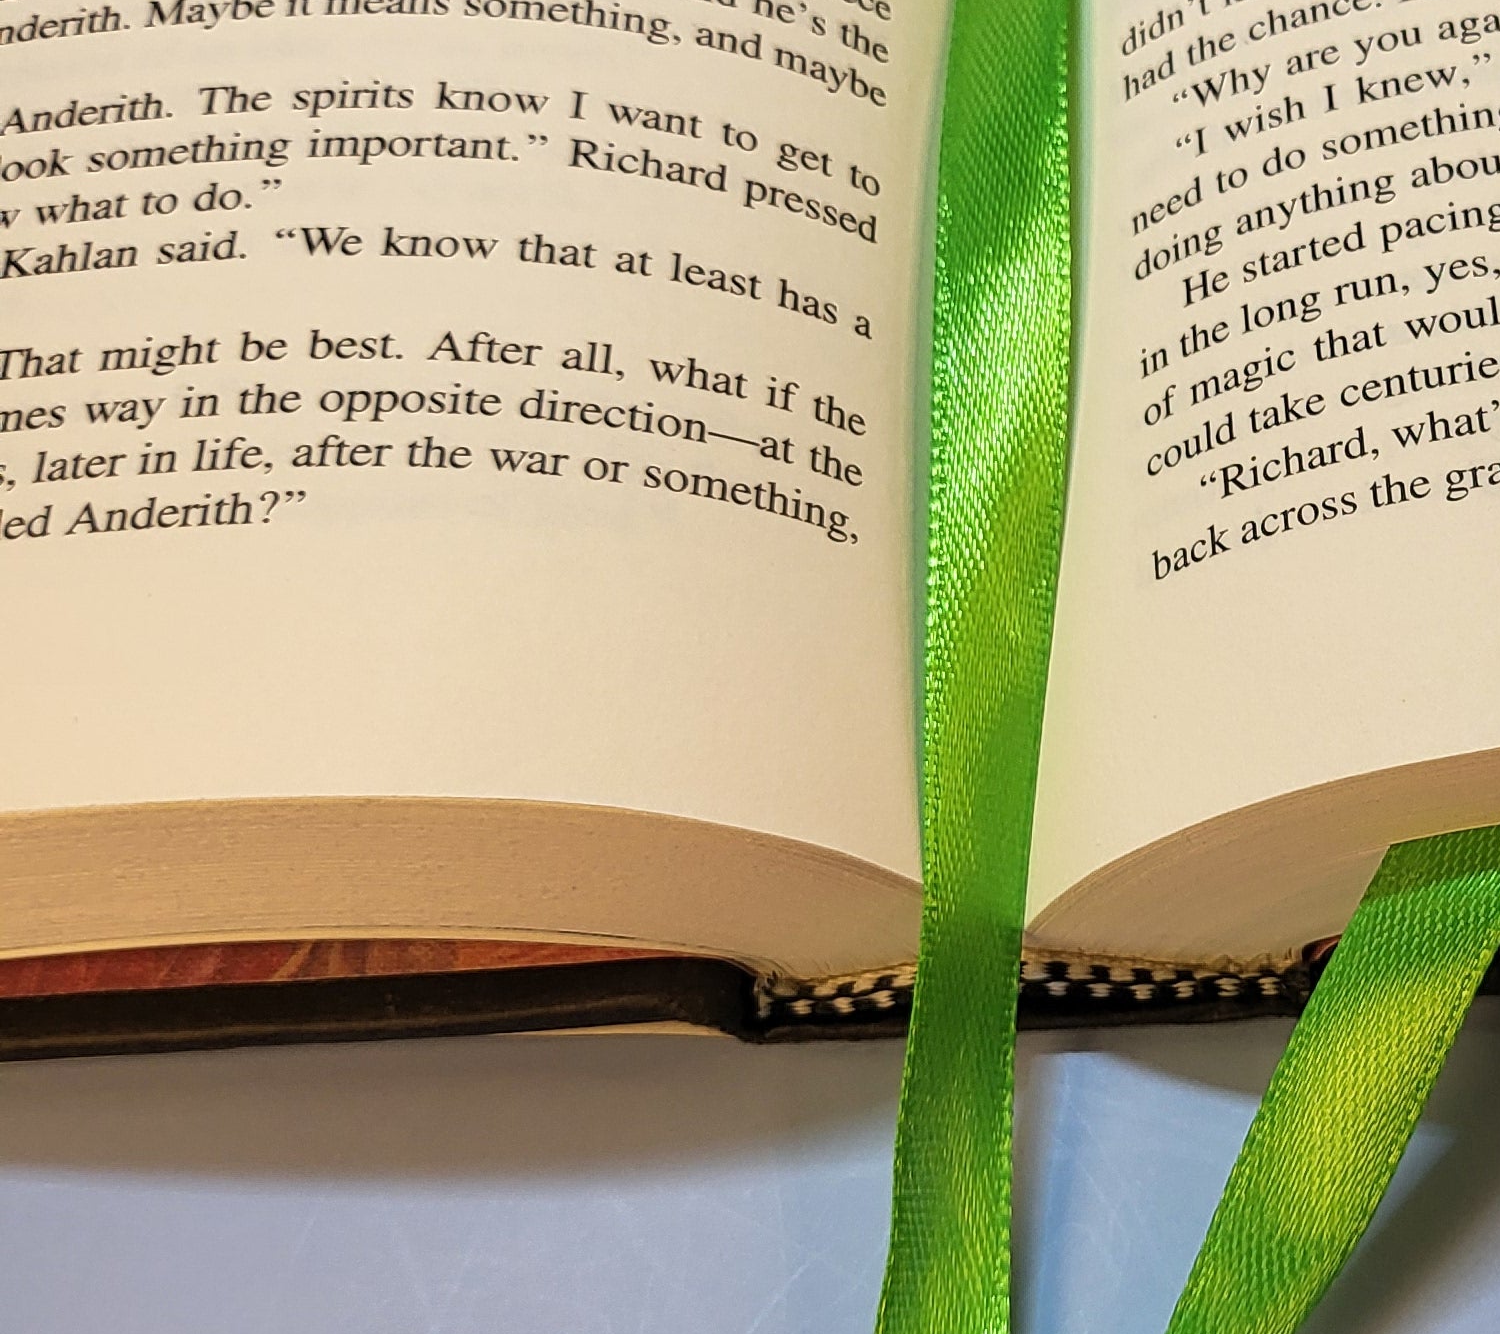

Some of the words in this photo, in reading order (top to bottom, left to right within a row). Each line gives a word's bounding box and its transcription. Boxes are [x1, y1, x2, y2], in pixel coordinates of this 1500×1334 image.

[1171, 63, 1272, 108] “Why
[1285, 45, 1340, 77] are
[1352, 26, 1423, 67] you
[0, 91, 174, 138] Anderith.
[196, 84, 273, 117] The
[291, 79, 415, 119] spirits
[434, 80, 551, 115] know
[569, 89, 589, 121] I
[606, 102, 703, 140] want
[720, 122, 760, 153] to
[774, 142, 833, 178] get
[848, 164, 882, 198] to
[1181, 269, 1230, 309] He
[1241, 220, 1367, 284] started
[0, 346, 84, 382] That
[97, 334, 221, 378] might
[238, 330, 289, 363] be
[307, 328, 405, 361] best.
[425, 330, 545, 368] After
[559, 341, 626, 383] all,
[647, 356, 749, 401] what
[764, 376, 801, 413] if
[812, 394, 867, 438] the
[1145, 411, 1237, 478] could
[1247, 392, 1326, 435] take
[30, 450, 129, 485] later
[136, 441, 178, 477] in
[190, 436, 274, 473] life,
[289, 433, 395, 469] after
[406, 435, 473, 471] the
[488, 448, 571, 478] war
[581, 457, 631, 485] or
[641, 465, 860, 546] something,
[62, 489, 308, 537] Anderith?”
[1150, 524, 1232, 582] back
[1240, 491, 1359, 546] across
[1368, 473, 1432, 510] the
